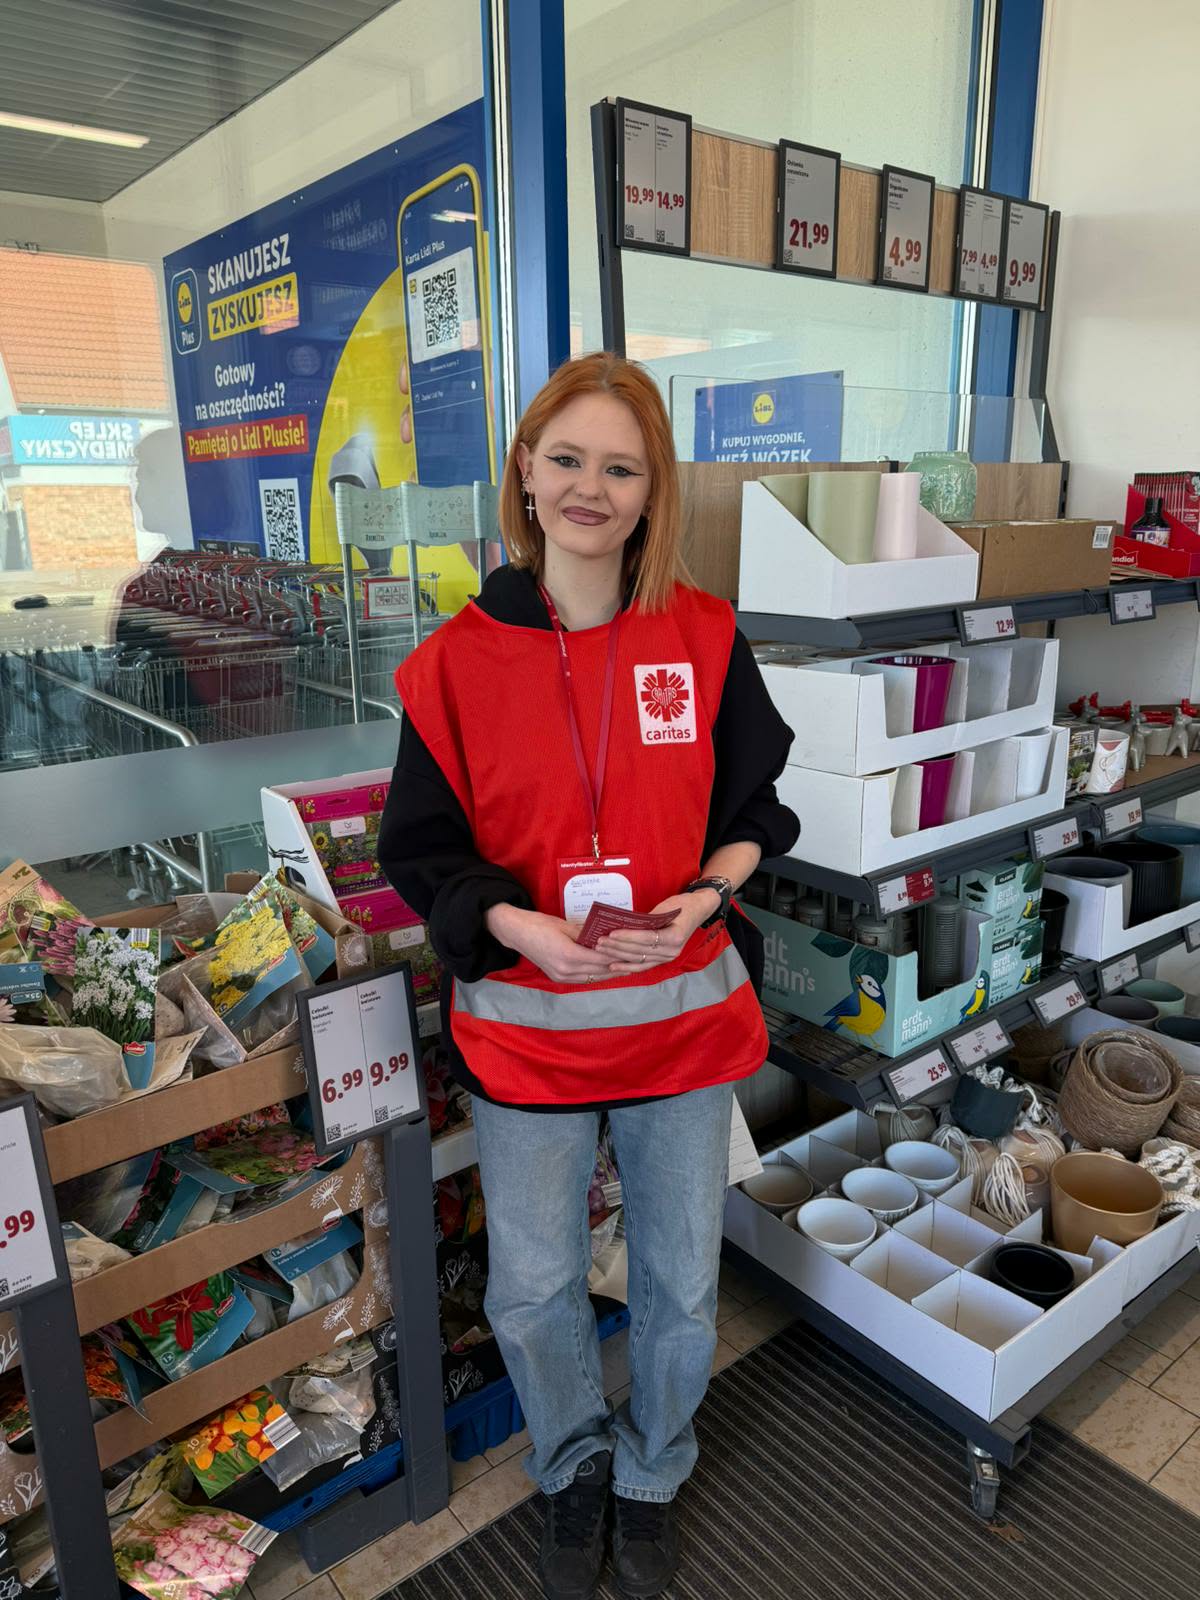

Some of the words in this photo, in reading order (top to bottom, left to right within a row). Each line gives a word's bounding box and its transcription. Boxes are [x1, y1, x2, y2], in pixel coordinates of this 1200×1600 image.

[625, 185, 654, 205] 19.99
[657, 191, 684, 210] 14.99
[789, 218, 829, 249] 21.99
[432, 240, 446, 255] Plus
[889, 236, 921, 267] 4.99
[208, 233, 291, 294] SKANUJESZ
[1009, 259, 1036, 287] 9.99
[211, 281, 294, 335] ZYSKUJESZ
[181, 331, 195, 346] Plus
[215, 362, 255, 387] Gotowy
[195, 403, 208, 420] na
[209, 382, 285, 420] oszczędności?
[188, 430, 230, 460] Pamiętaj
[231, 435, 238, 451] o
[240, 425, 262, 450] Lidl
[263, 420, 305, 448] Plusie!
[722, 436, 751, 448] KUPUJ
[752, 432, 806, 445] WYGODNIE,
[996, 619, 1014, 633] 12.99
[646, 725, 691, 740] caritas
[763, 930, 788, 965] dt
[902, 1009, 923, 1029] erdt
[369, 1052, 409, 1087] 9.99
[928, 1062, 947, 1082] 25.99
[322, 1069, 364, 1104] 6.99
[0, 1209, 35, 1249] .99
[187, 1438, 200, 1450] 10
